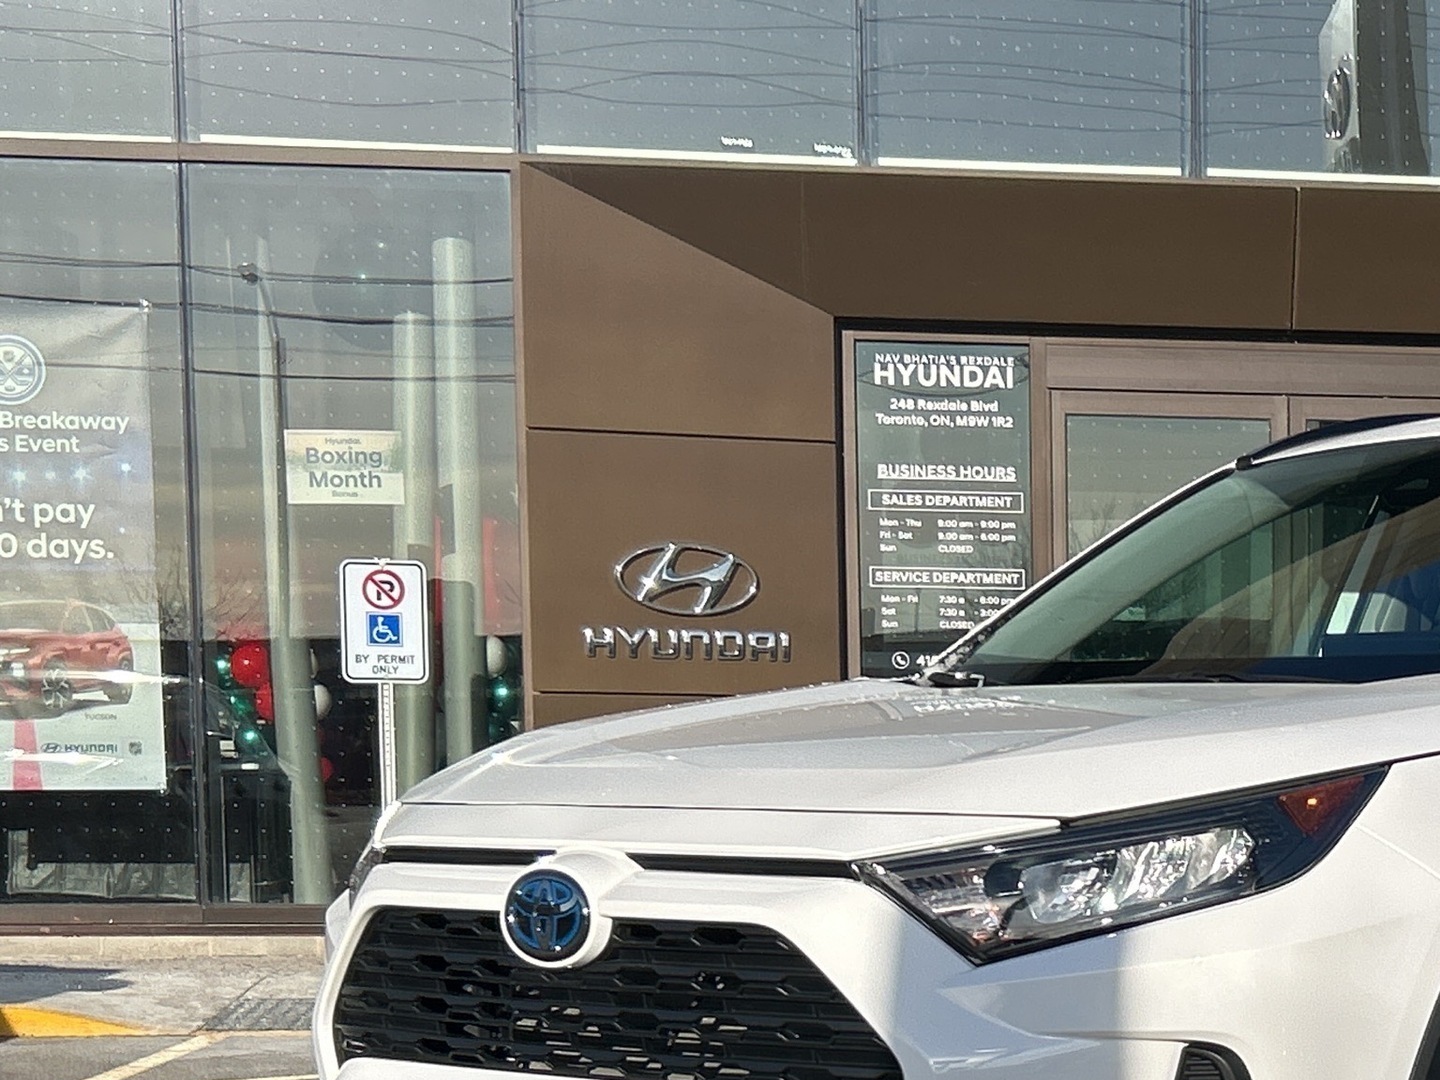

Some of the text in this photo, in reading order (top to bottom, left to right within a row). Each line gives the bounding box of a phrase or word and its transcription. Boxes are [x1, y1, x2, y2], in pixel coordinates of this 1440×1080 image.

[875, 353, 1015, 367] NAV BHATIA'S REXDALE
[873, 363, 1014, 389] HYUNDAI
[889, 398, 999, 412] 248 Rexdale Blvd
[0, 411, 130, 434] Breakaway
[875, 413, 1014, 428] Toronto, ON, M9W 1R2
[15, 434, 80, 453] Event
[305, 446, 383, 468] Boxing
[309, 470, 382, 488] Month
[877, 463, 1017, 480] BUSINESS HOURS
[881, 494, 1013, 508] SALES DEPARTMENT
[33, 503, 95, 528] pay
[27, 532, 115, 564] days.
[937, 545, 974, 553] CLOSED
[875, 570, 1020, 585] SERVICE DEPARTMENT
[582, 627, 792, 663] HYUNDAI
[355, 654, 415, 665] BY PERMIT
[372, 665, 399, 675] ONLY
[64, 744, 118, 753] HYUNDAI
